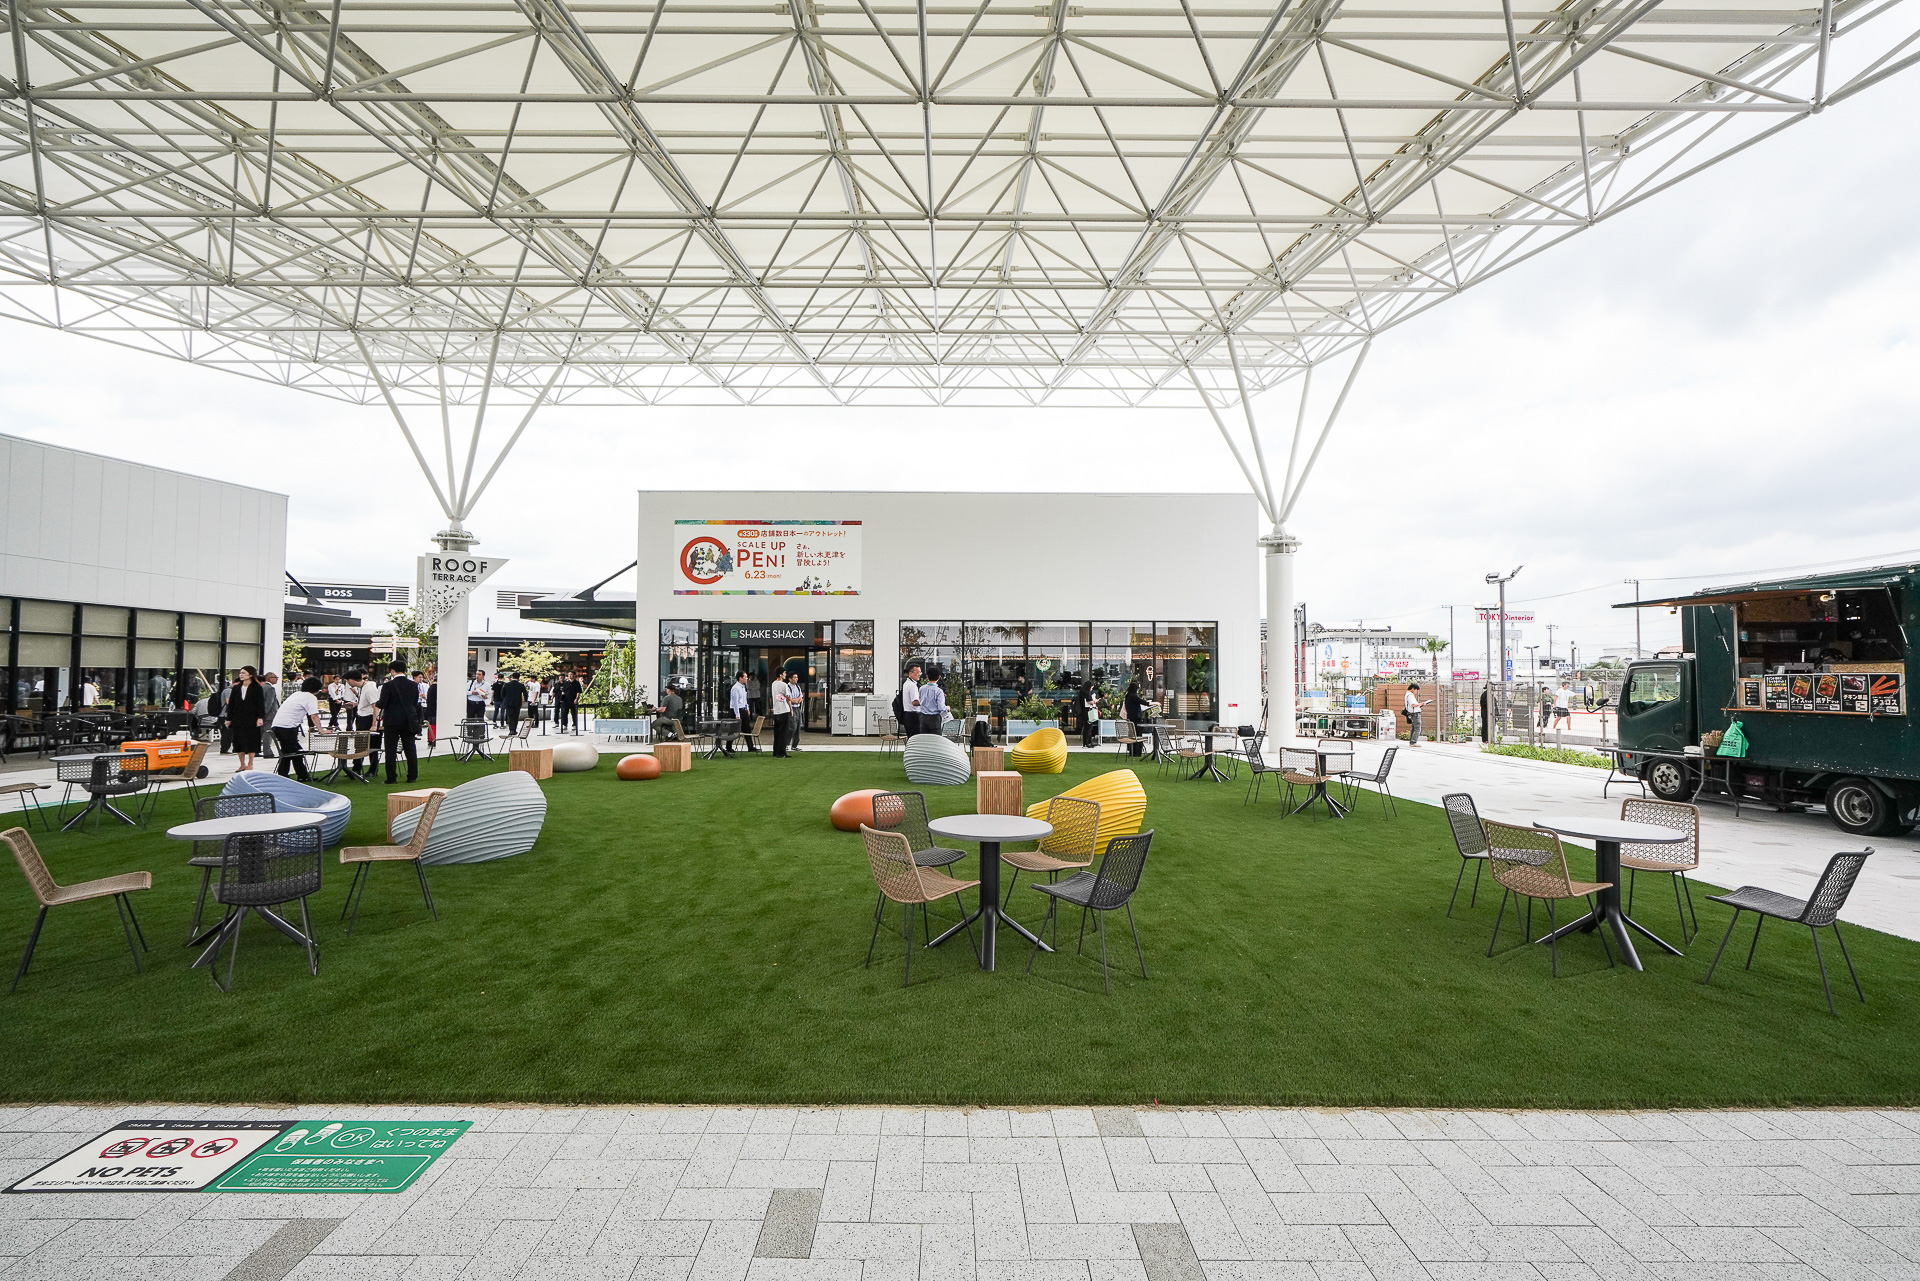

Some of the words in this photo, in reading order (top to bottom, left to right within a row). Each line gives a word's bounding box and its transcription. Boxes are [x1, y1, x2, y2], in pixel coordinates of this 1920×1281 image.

[737, 541, 766, 549] SCALE
[770, 541, 786, 551] UP
[432, 557, 488, 574] ROOF
[432, 572, 477, 583] TERRACE
[324, 589, 353, 598] BOSS
[739, 629, 771, 639] SHAKE
[772, 629, 805, 639] SHACK
[324, 649, 352, 658] BOSS
[337, 1133, 370, 1142] OK
[386, 1128, 460, 1137] くつのまま
[369, 1139, 446, 1149] はいってね
[77, 1166, 124, 1178] NO
[122, 1166, 184, 1178] PETS
